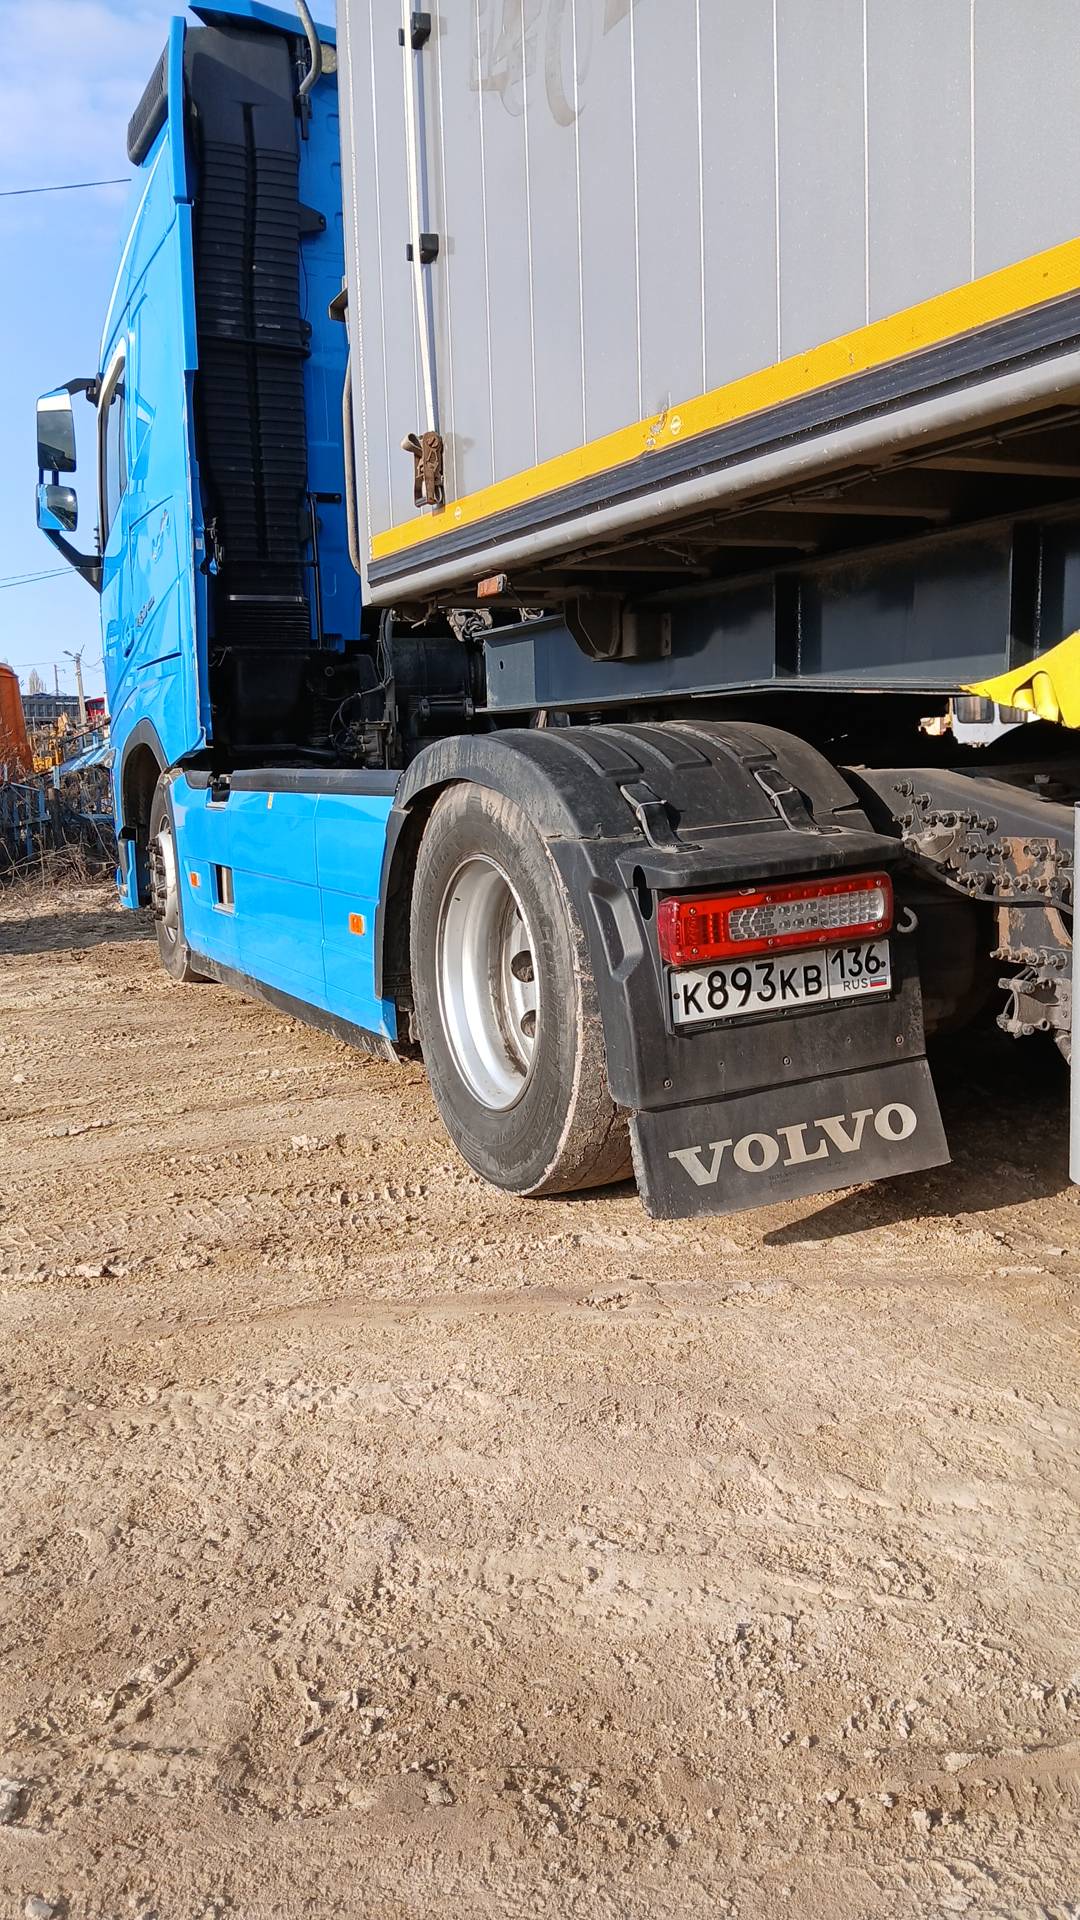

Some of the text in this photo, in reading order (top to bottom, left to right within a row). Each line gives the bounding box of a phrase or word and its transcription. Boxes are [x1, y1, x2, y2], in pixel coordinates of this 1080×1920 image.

[831, 944, 881, 978] 136
[843, 977, 868, 992] RUS
[668, 1102, 917, 1186] VOLVO
